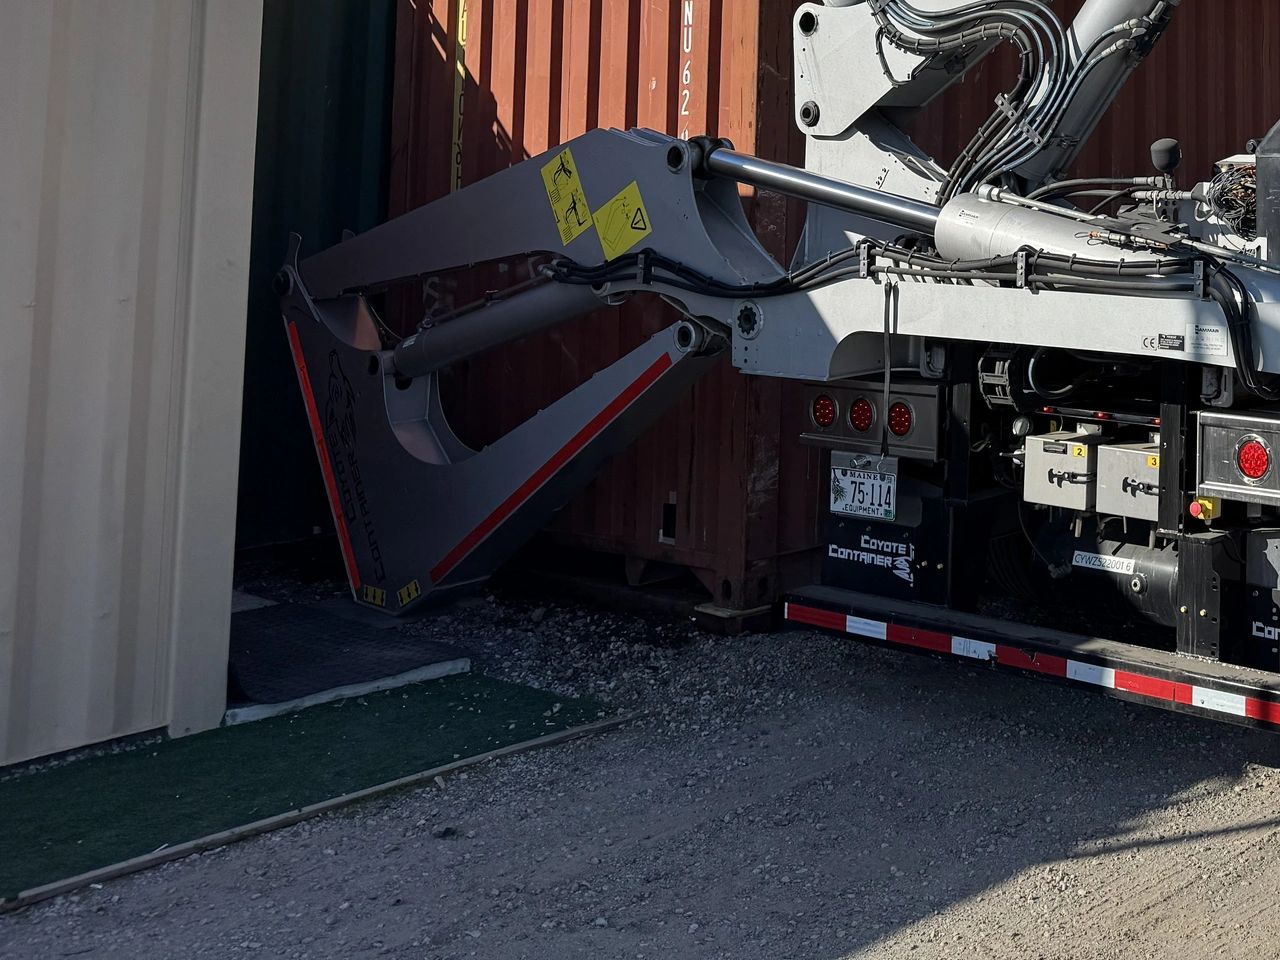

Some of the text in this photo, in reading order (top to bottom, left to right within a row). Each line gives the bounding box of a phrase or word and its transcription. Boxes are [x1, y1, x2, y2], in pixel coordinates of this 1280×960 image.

[1077, 448, 1083, 456] 2
[1151, 457, 1157, 466] 3
[849, 472, 878, 481] MAINE
[861, 534, 907, 554] COYOTE
[828, 543, 892, 568] CONTAINER
